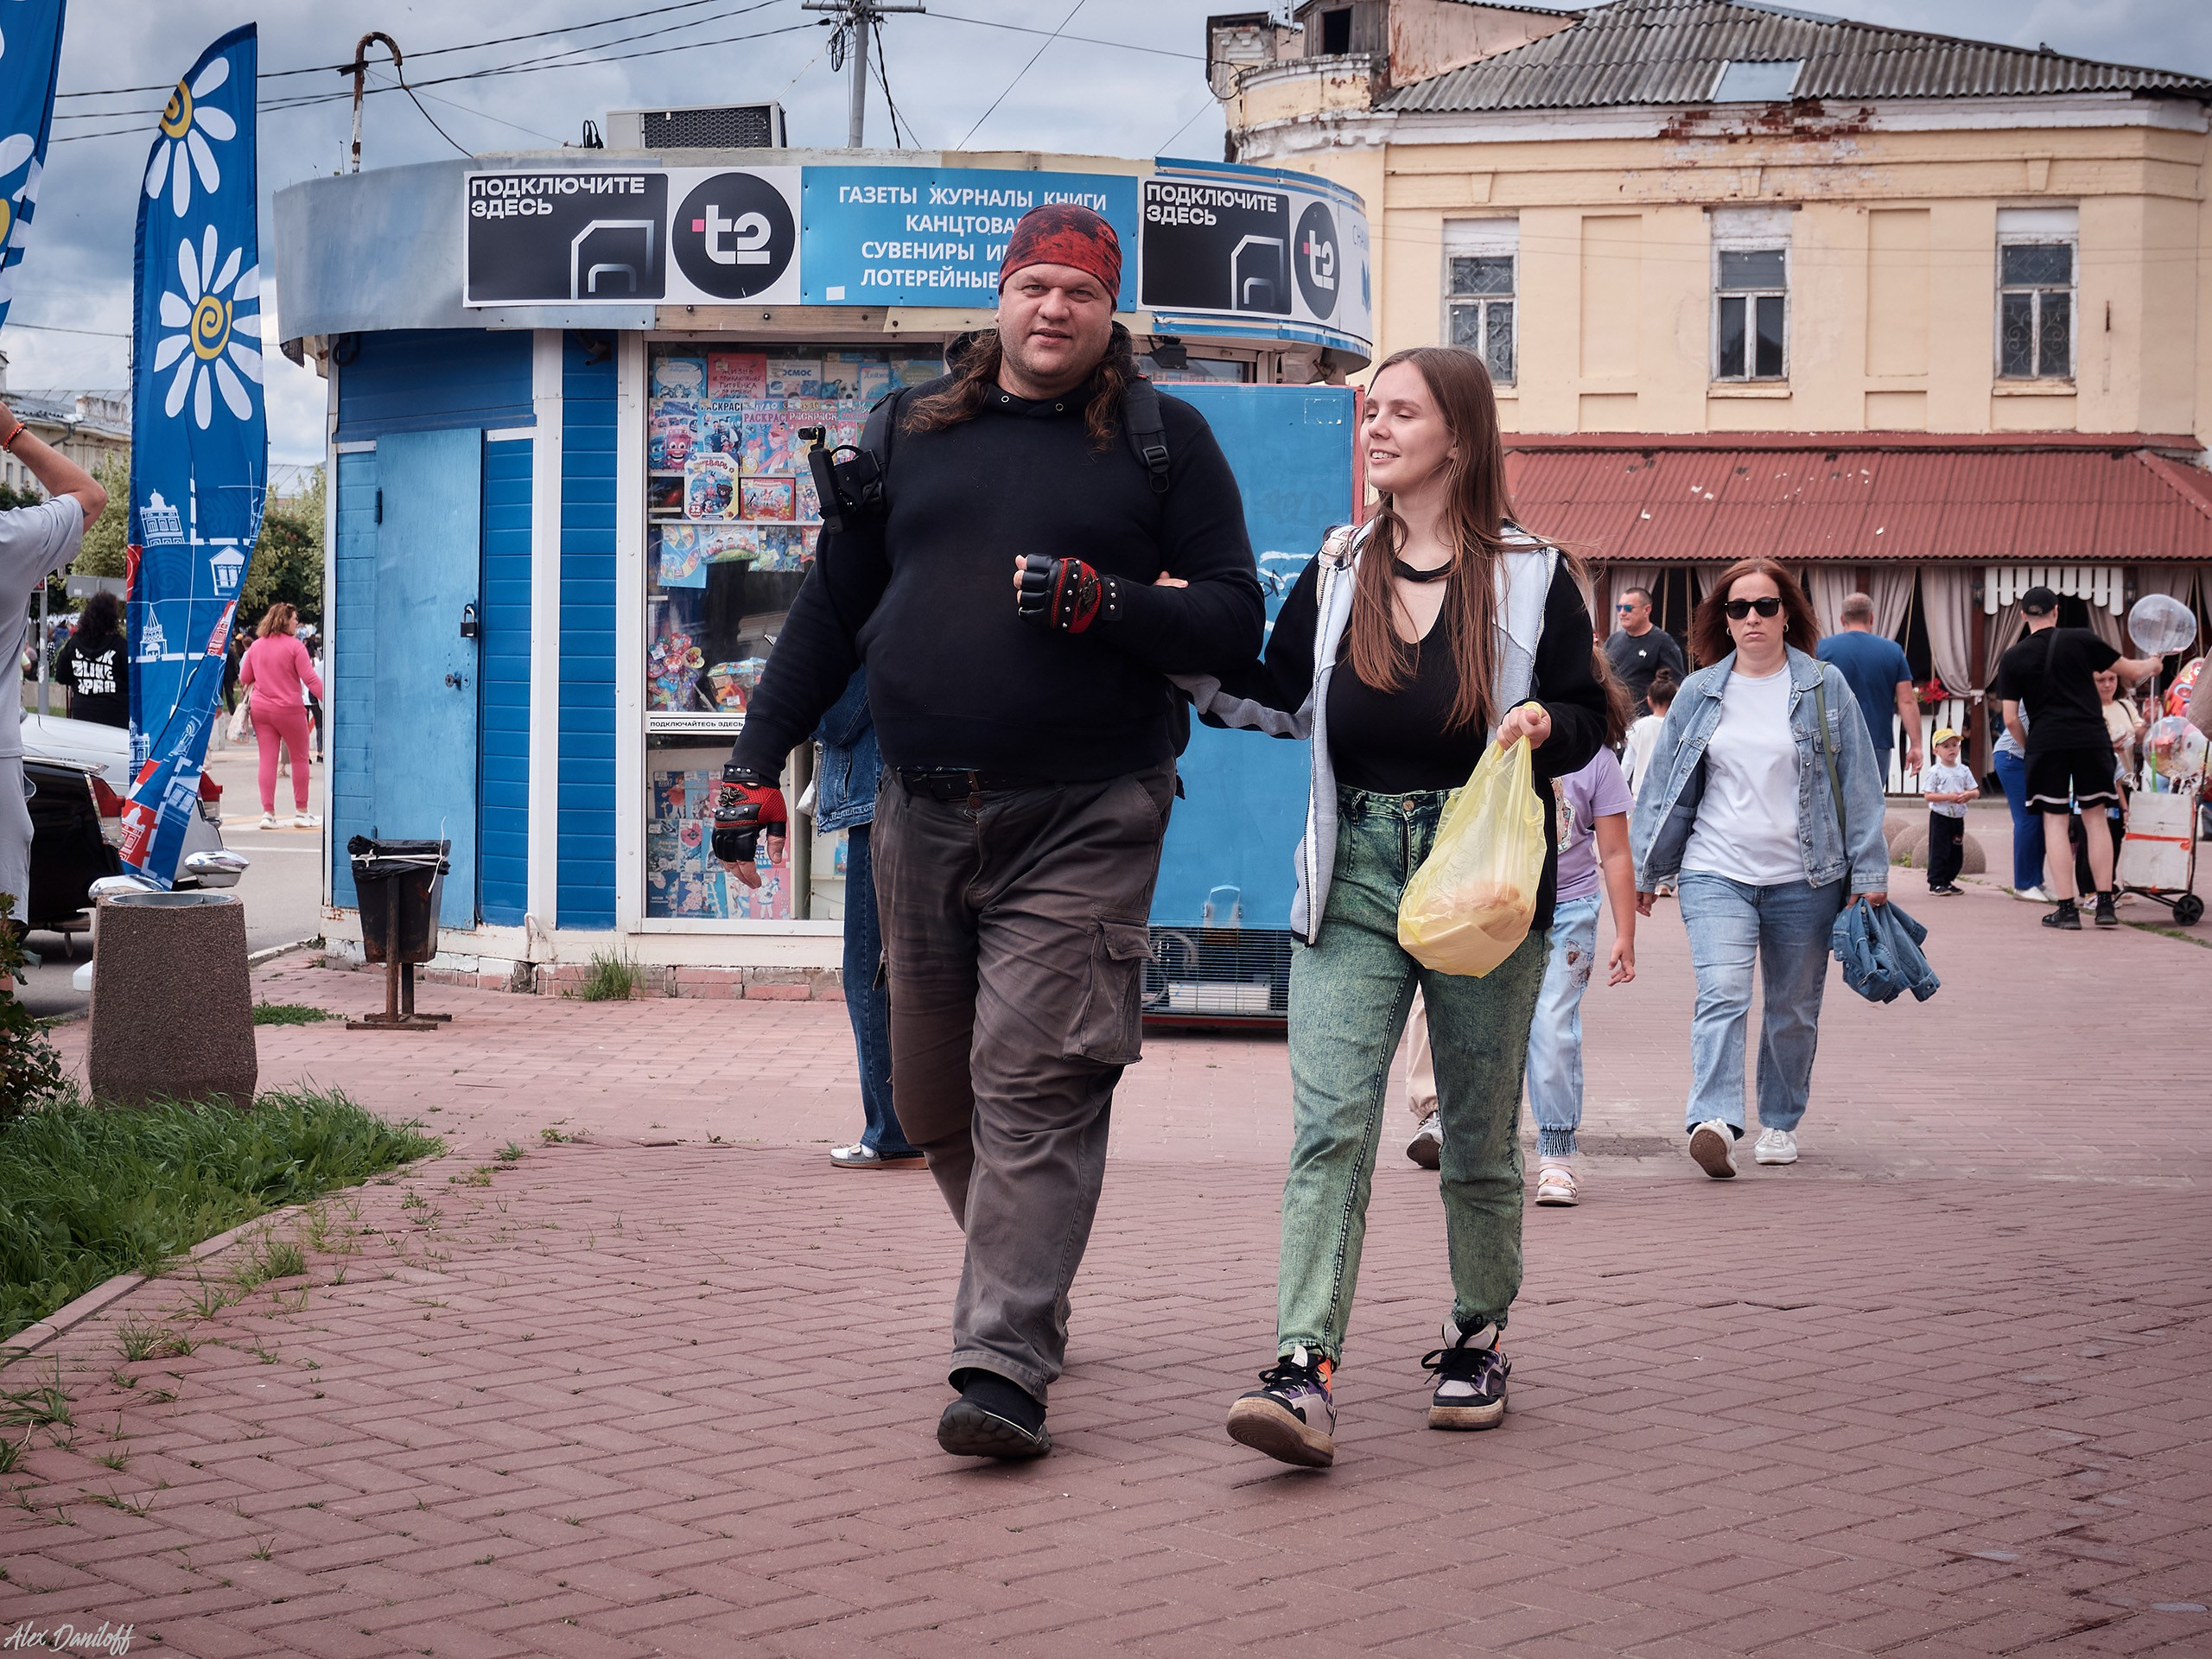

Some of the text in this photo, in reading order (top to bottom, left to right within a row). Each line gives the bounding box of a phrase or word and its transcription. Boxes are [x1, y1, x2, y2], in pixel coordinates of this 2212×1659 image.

[471, 175, 645, 198] ПОДКЛЮЧИТЕ
[838, 185, 1107, 212] ГАЗЕТЫ ЖУРНАЛЫ КНИГИ
[1147, 184, 1277, 213] ПОДКЛЮЧИТЕ
[471, 198, 553, 219] ЗДЕСЬ
[1146, 205, 1217, 226] ЗДЕСЬ
[704, 204, 772, 265] t2
[906, 214, 1021, 238] КАНЦТОВА
[861, 240, 975, 261] СУВЕНИРЫ
[1308, 229, 1335, 290] t2
[861, 265, 1000, 289] ЛОТЕРЕЙНЫЕ
[785, 370, 818, 378] ОСМОС
